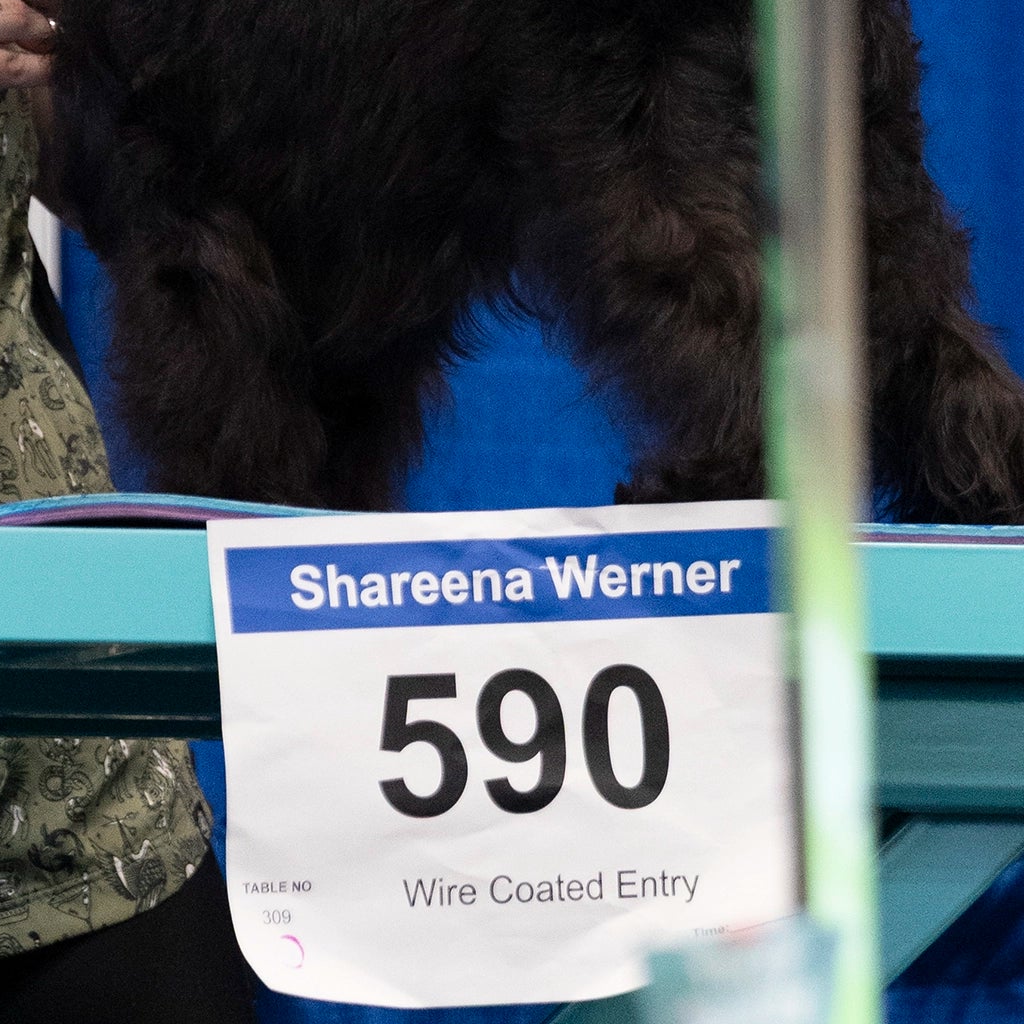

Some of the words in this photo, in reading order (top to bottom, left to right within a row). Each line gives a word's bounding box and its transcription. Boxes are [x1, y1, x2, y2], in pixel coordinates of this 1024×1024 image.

[290, 562, 533, 610] Shareena
[545, 554, 741, 599] Werner
[378, 663, 670, 818] 590
[242, 880, 288, 894] TABLE
[292, 880, 312, 893] NO
[402, 877, 477, 908] Wire
[489, 871, 604, 905] Coated
[617, 869, 699, 903] Entry
[262, 909, 292, 925] 309
